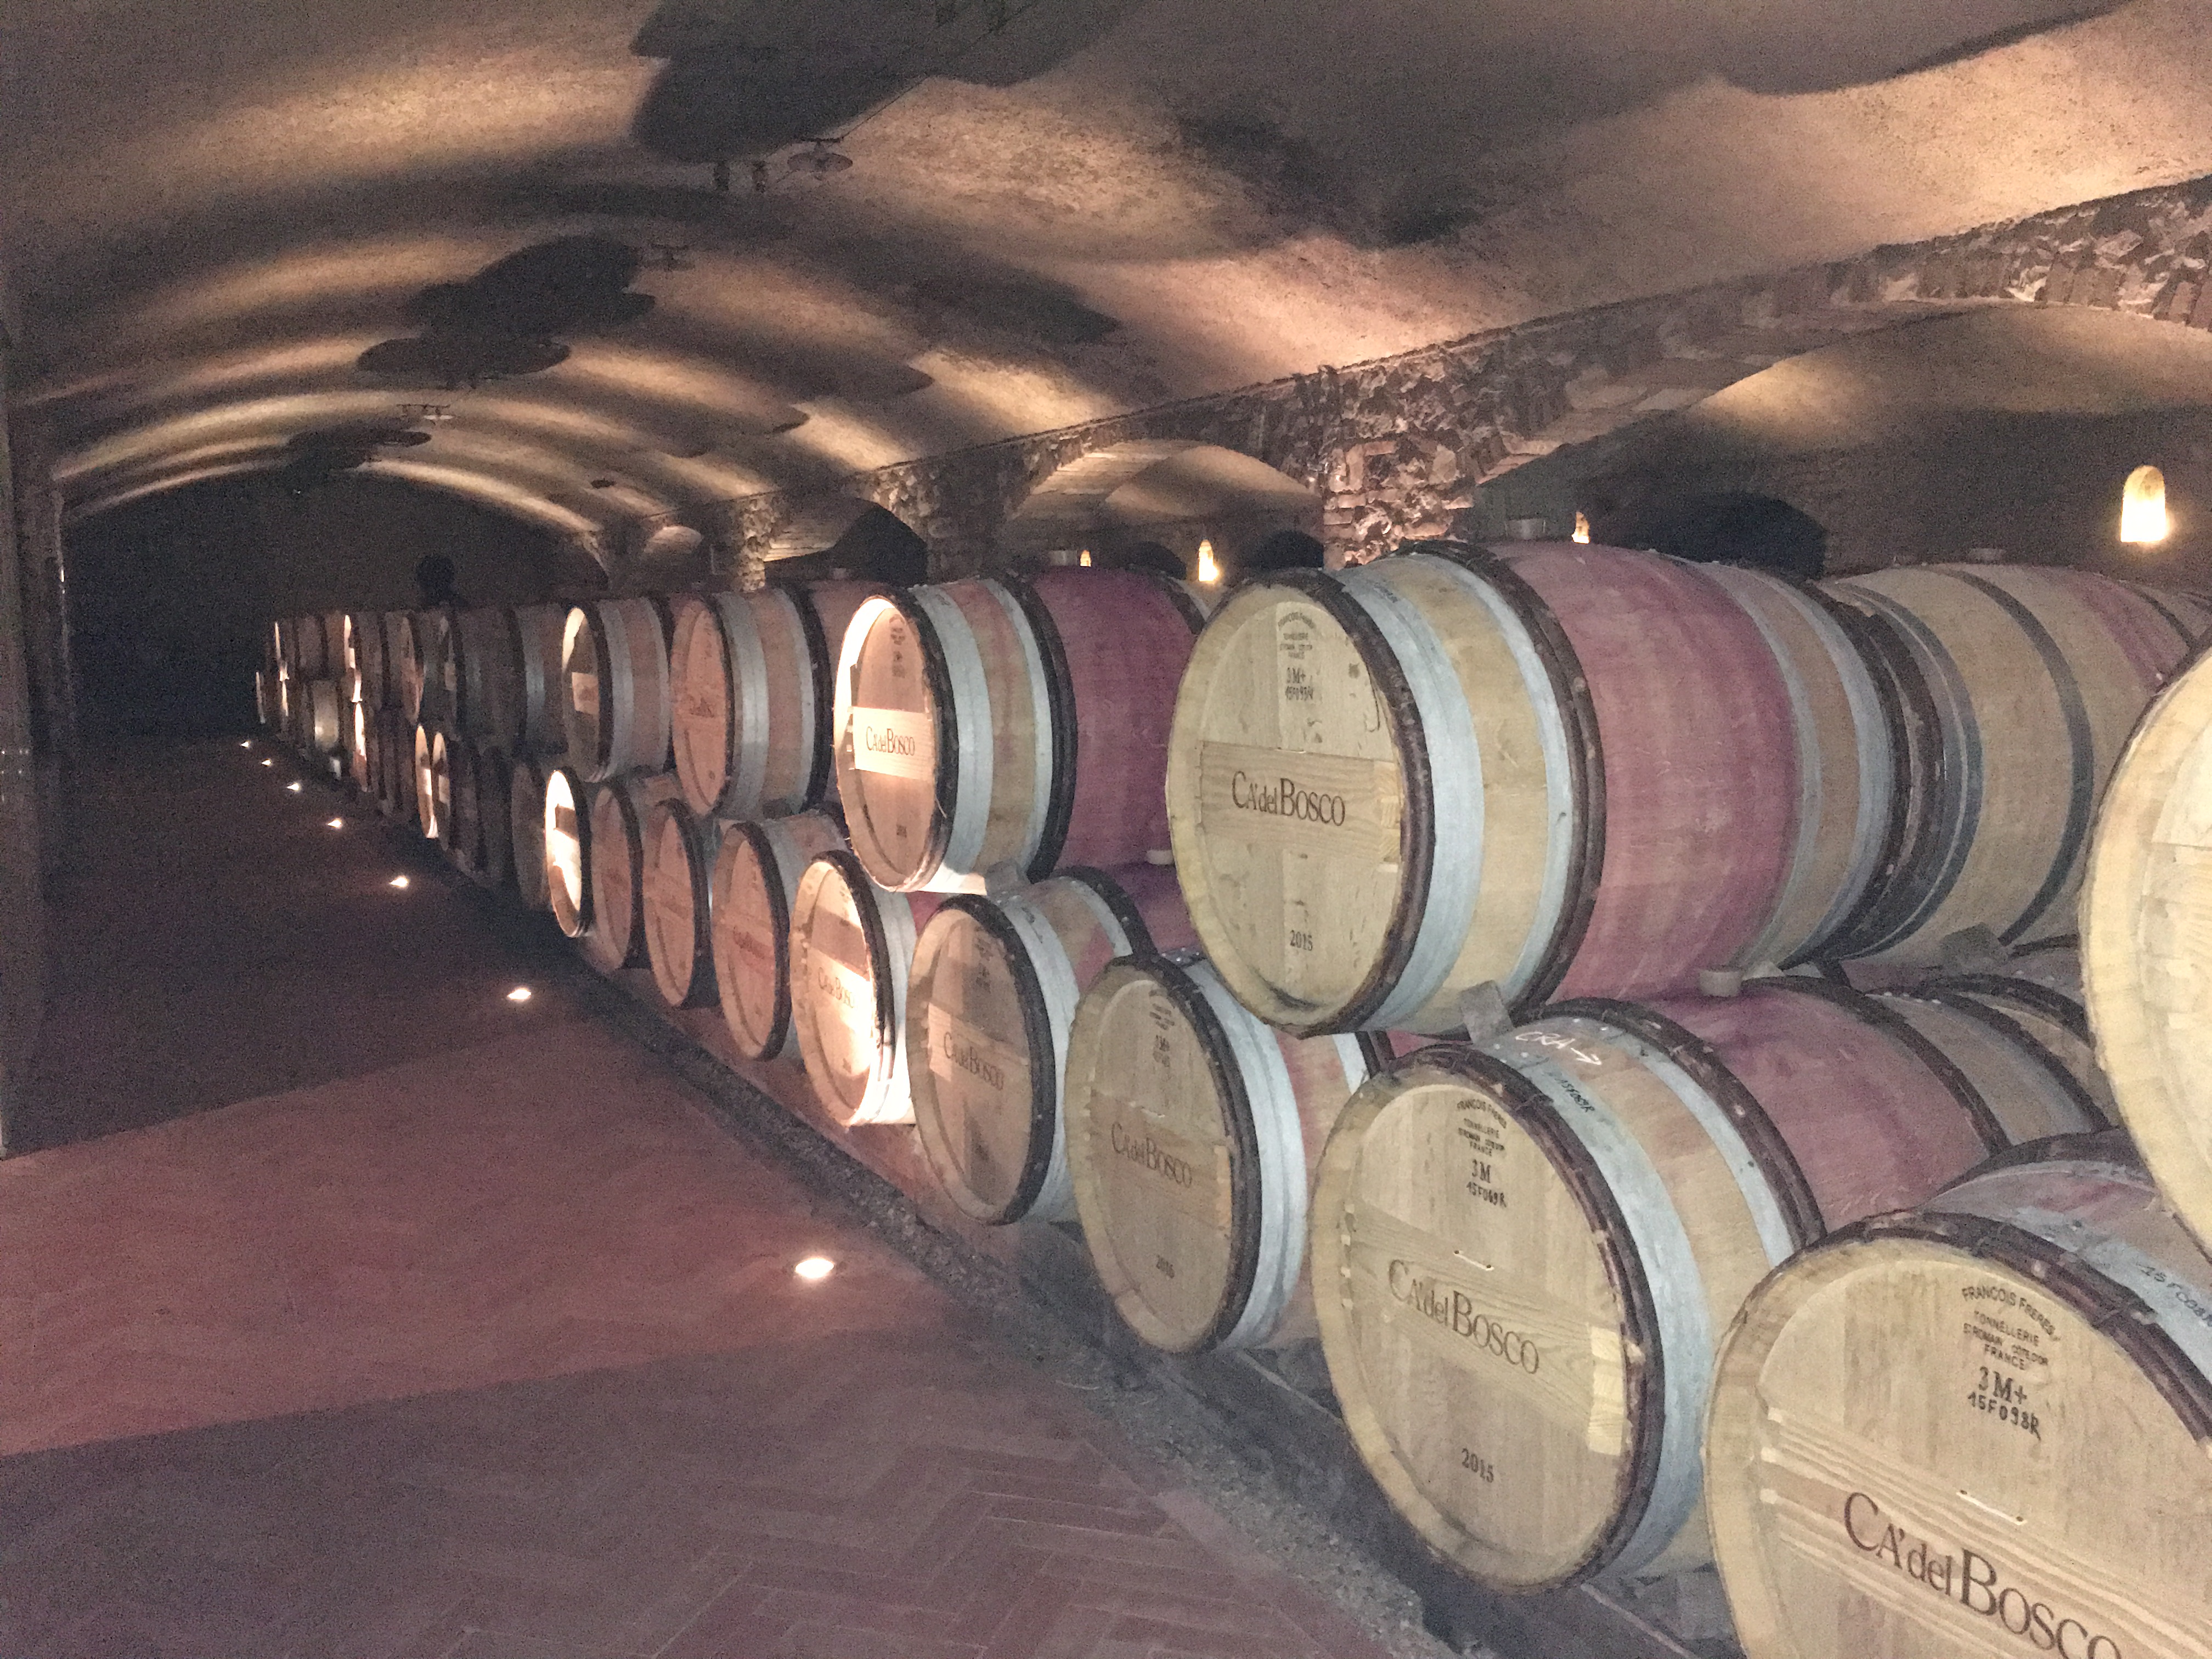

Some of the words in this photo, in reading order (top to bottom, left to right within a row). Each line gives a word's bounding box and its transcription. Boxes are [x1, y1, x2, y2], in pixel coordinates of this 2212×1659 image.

[1290, 929, 1313, 951] 2015
[1984, 1344, 2025, 1370] FRANCE
[1461, 1448, 1494, 1483] 2015
